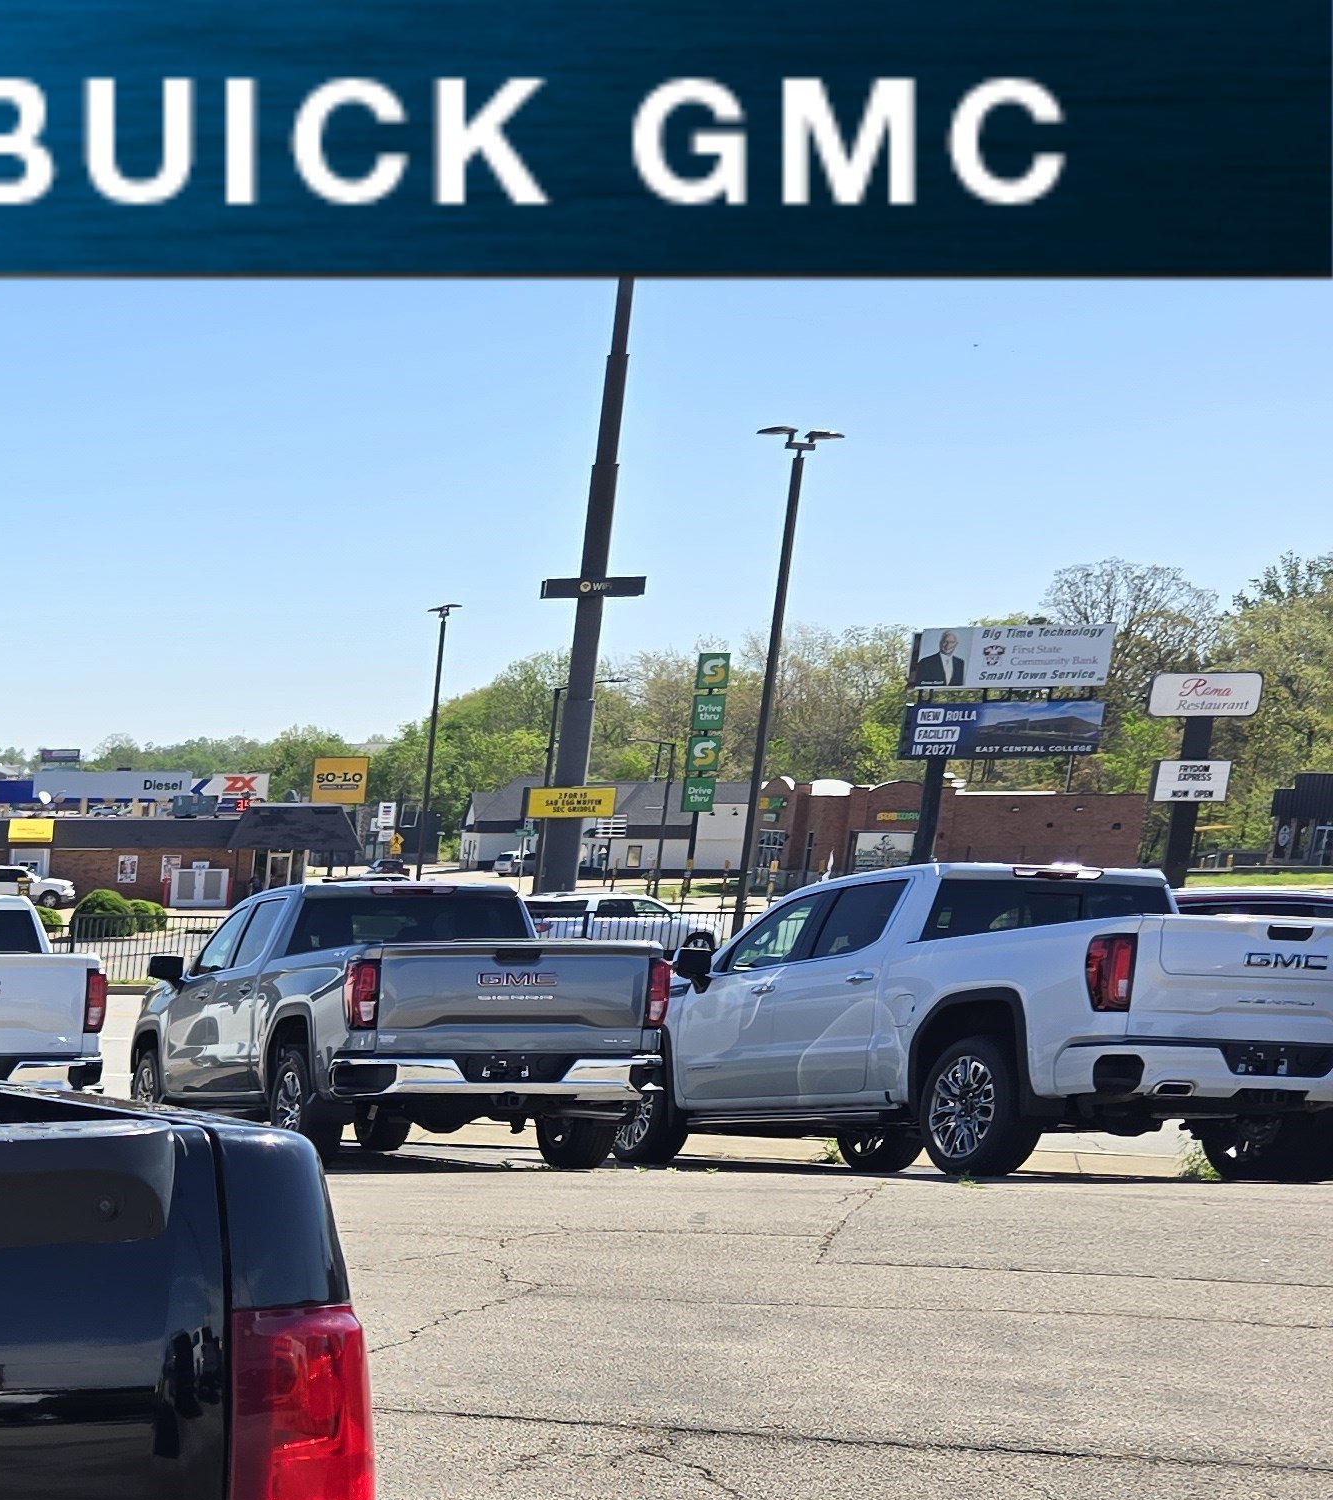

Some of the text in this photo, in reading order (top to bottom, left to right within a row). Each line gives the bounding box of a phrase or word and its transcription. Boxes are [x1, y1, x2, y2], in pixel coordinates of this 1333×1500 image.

[982, 626, 1105, 641] Big Time Technology
[1012, 644, 1063, 654] First State
[1010, 655, 1071, 668] Community
[1071, 655, 1099, 666] Bank
[978, 670, 1013, 682] Small
[1017, 669, 1048, 680] Town
[1050, 668, 1096, 680] Service
[698, 704, 723, 713] Drive
[1176, 700, 1250, 711] Restaurant
[699, 711, 720, 721] thru
[919, 710, 977, 722] NEW ROLLA
[916, 728, 959, 741] FACILITY
[911, 744, 923, 756] IN
[975, 744, 1092, 753] EAST CENTRAL COLLEGE
[316, 772, 363, 784] SO-LO
[1177, 773, 1212, 782] EXPRESS
[143, 779, 183, 791] Diesel
[688, 786, 713, 795] Drive
[689, 793, 710, 803] thru
[1171, 789, 1215, 798] NOW OPEN
[1243, 951, 1328, 970] GMC
[477, 971, 558, 988] GMC
